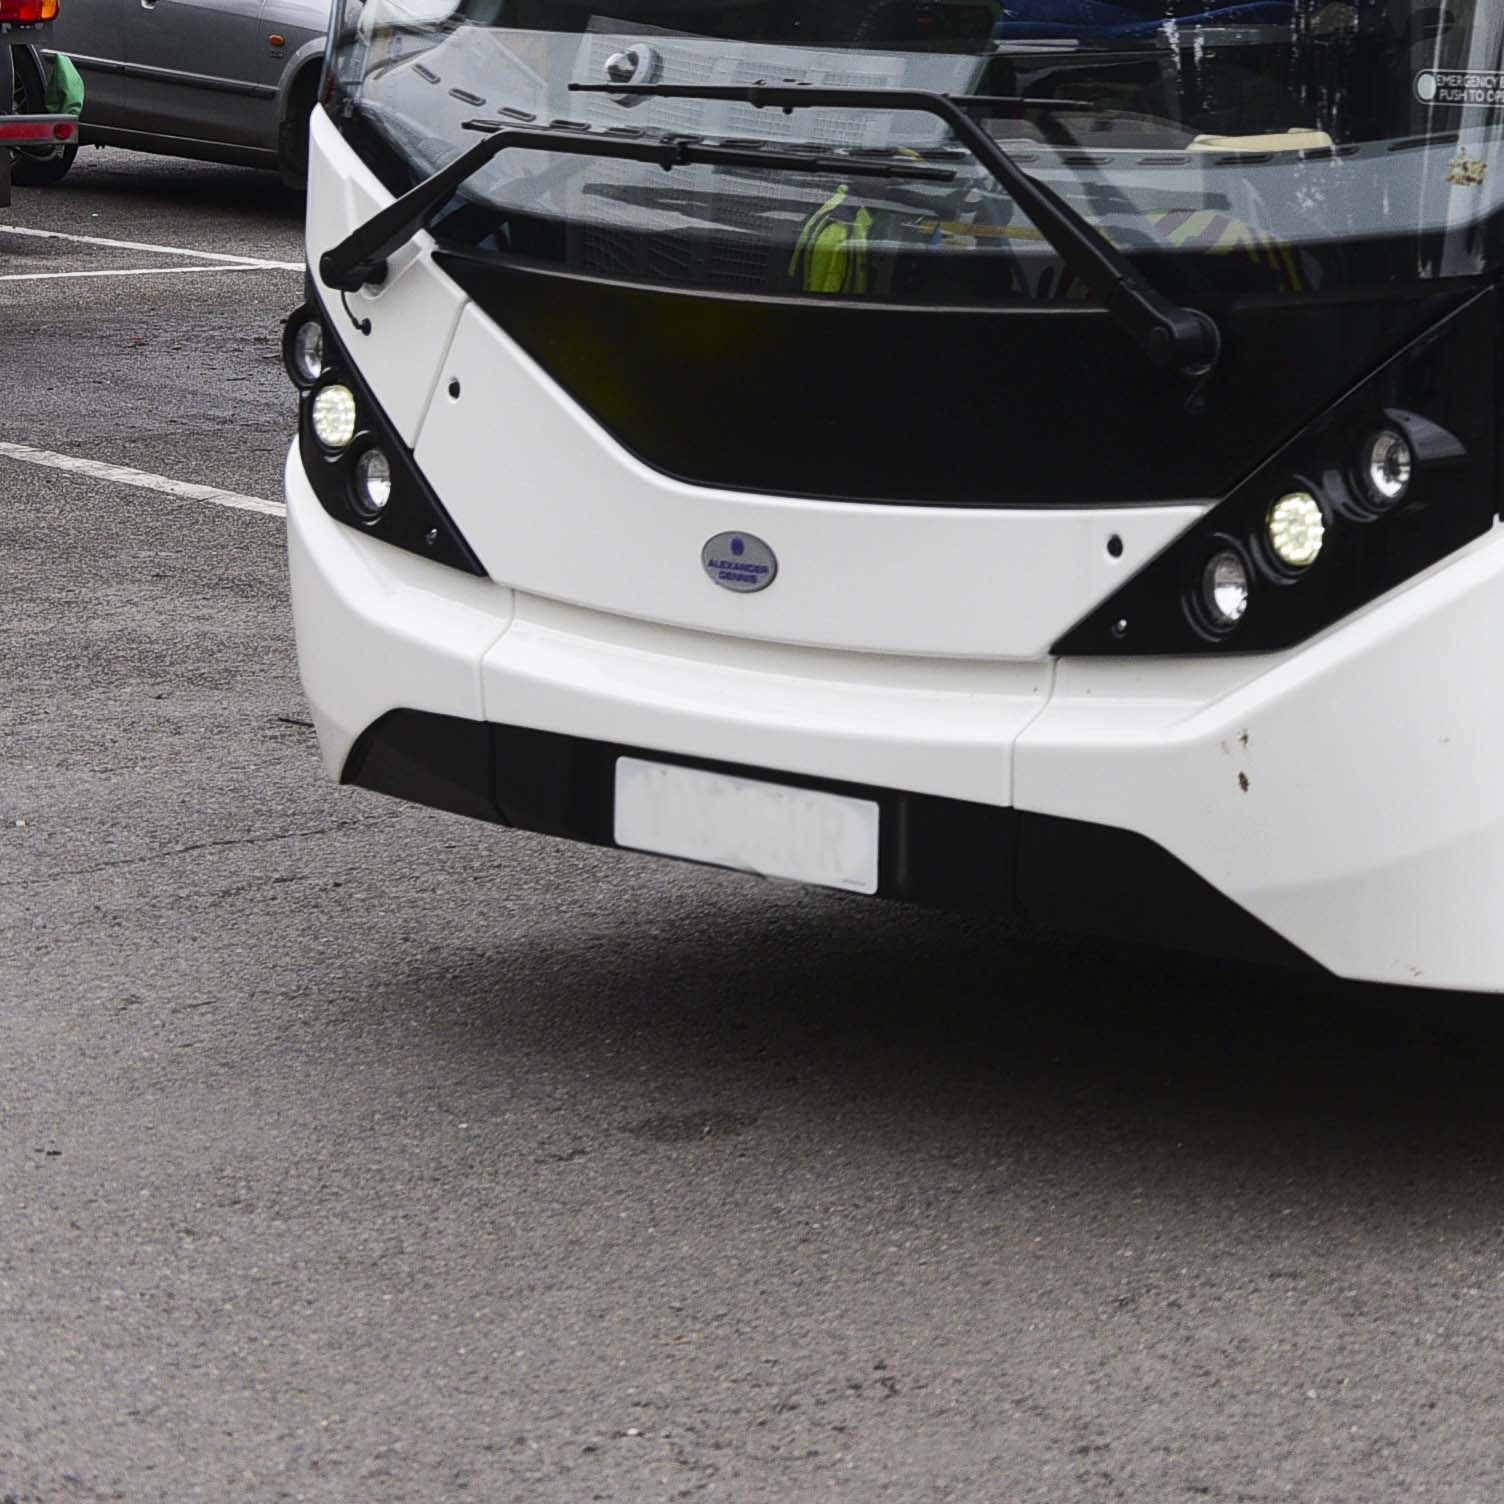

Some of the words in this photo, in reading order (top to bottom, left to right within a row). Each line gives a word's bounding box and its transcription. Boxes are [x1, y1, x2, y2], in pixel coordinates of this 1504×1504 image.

[1436, 75, 1497, 88] EMERGENCY
[1439, 89, 1467, 101] PUSH
[1469, 90, 1485, 102] TO
[707, 559, 769, 574] ALEXANDER
